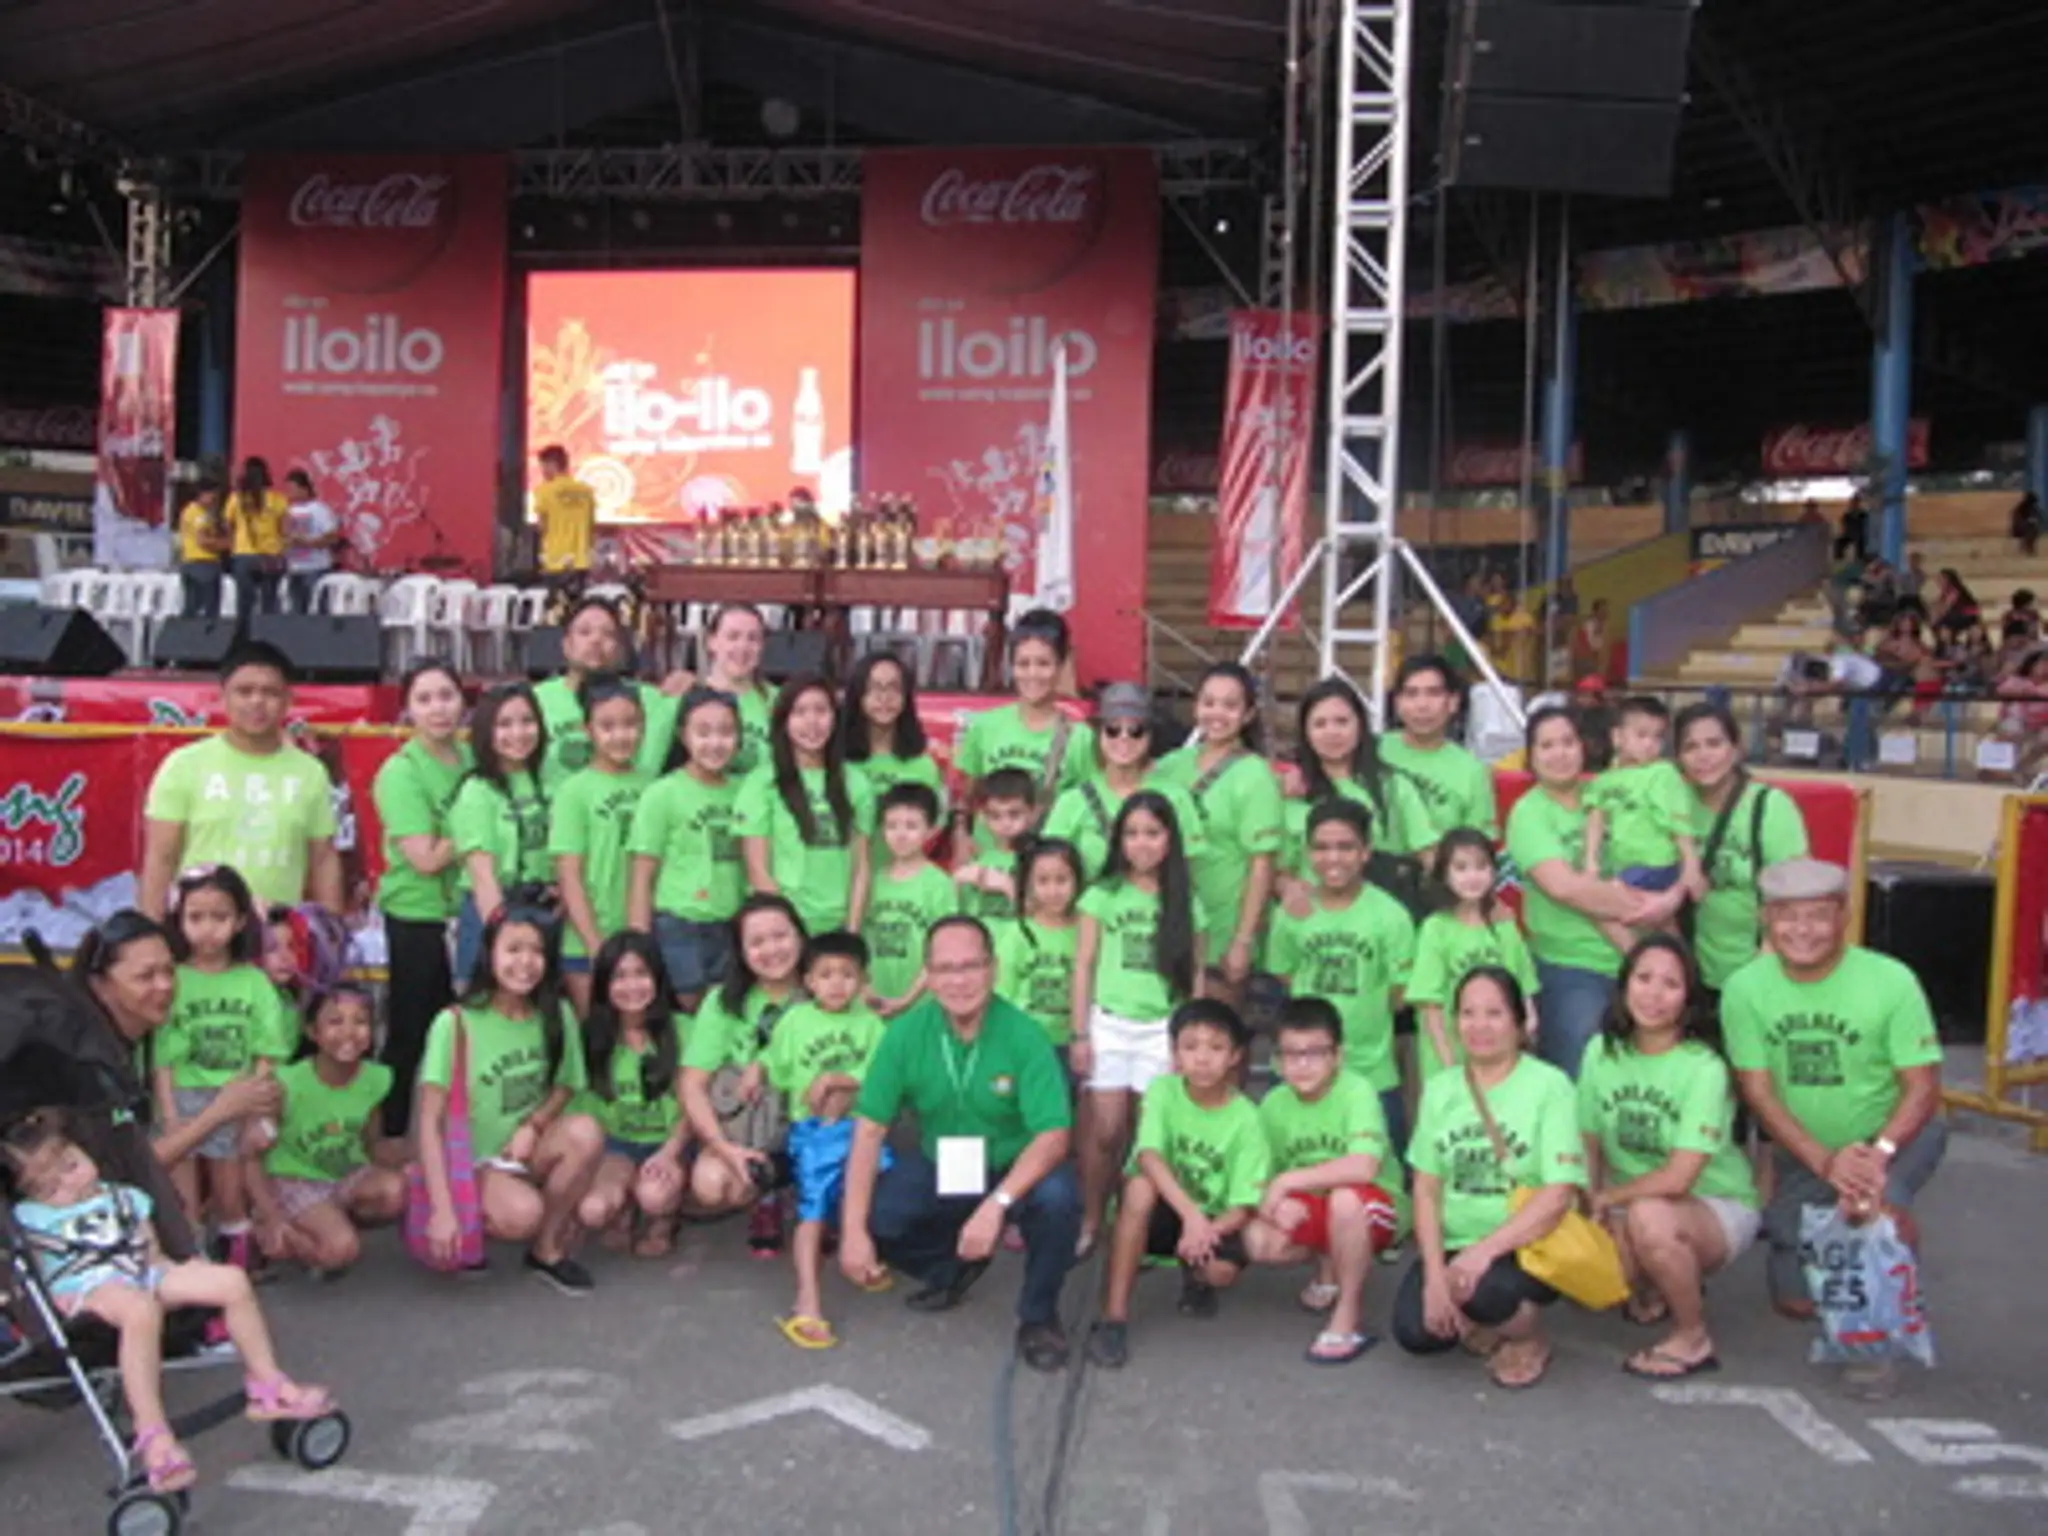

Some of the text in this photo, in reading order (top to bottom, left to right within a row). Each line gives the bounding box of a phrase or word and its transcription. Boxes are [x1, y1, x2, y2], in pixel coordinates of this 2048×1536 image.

[288, 172, 448, 226] Coca-Cola
[919, 165, 1091, 222] Coca-Cola
[282, 313, 445, 374] Iloilo
[917, 314, 1098, 379] Iloilo
